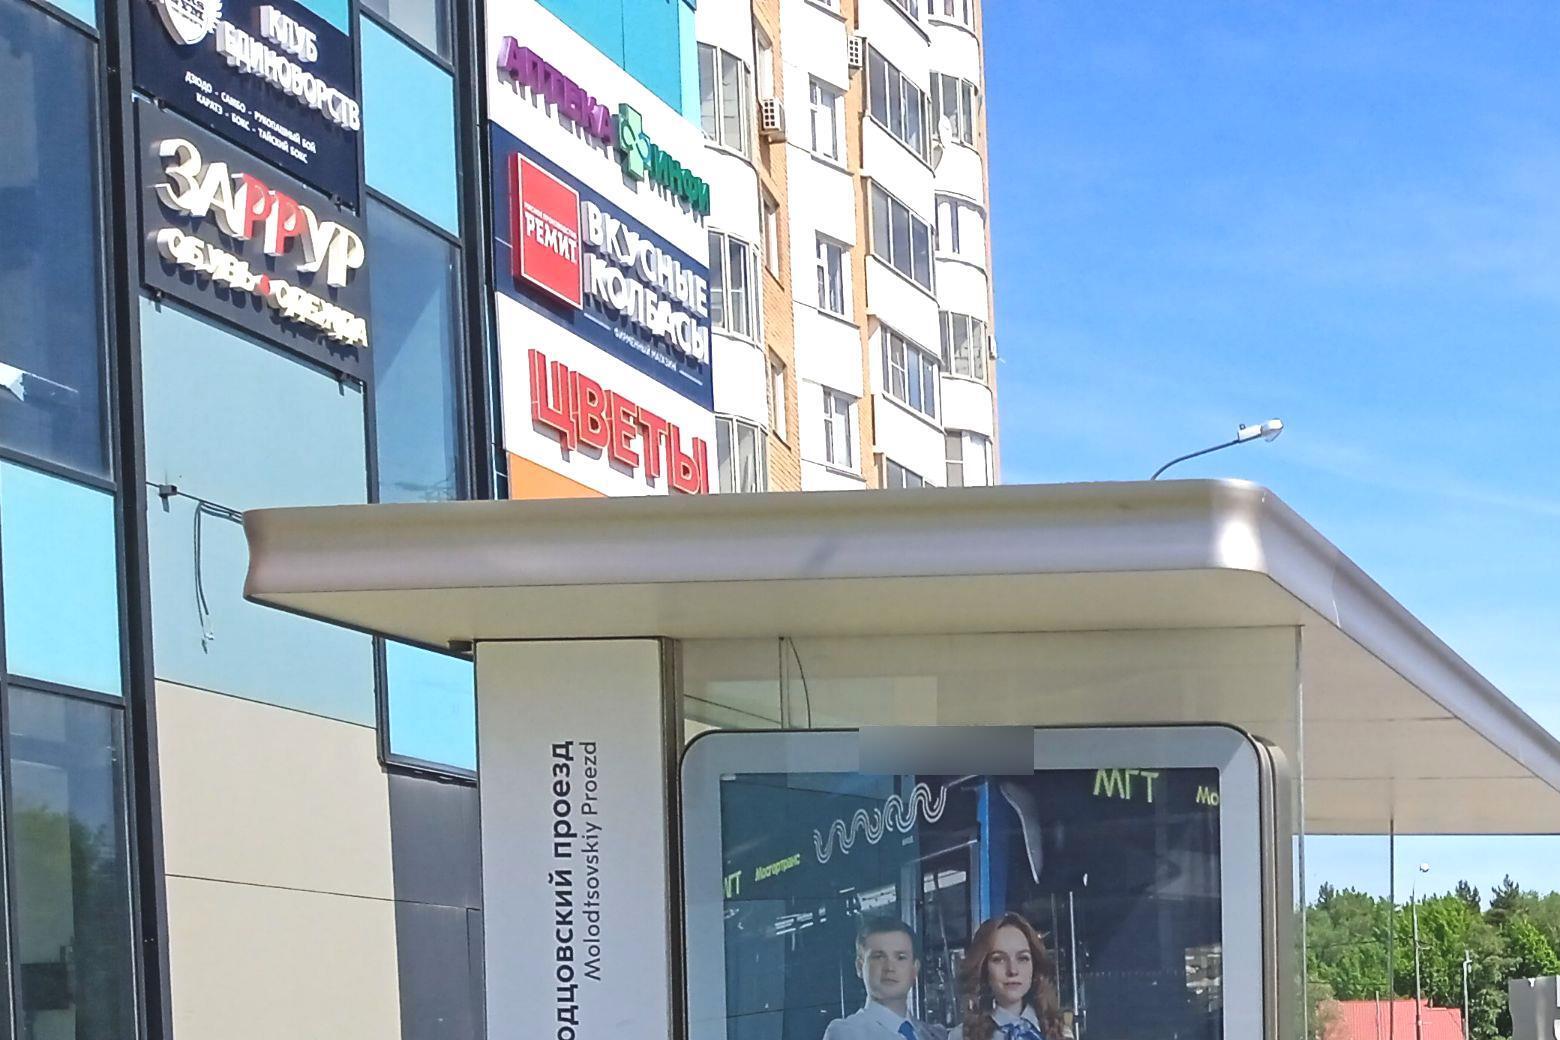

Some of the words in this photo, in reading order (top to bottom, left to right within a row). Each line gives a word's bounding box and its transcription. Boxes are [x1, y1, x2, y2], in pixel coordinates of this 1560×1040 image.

[216, 20, 361, 131] ЕДИНОБОРСТВ
[260, 5, 318, 63] КЛУБ
[497, 35, 612, 147] АПТЕКА
[154, 138, 365, 288] ЗАРРУР
[524, 211, 578, 265] РЕМИТ
[581, 200, 708, 319] ВКУСНЫЕ
[156, 227, 254, 293] ОБУВЬ
[267, 279, 369, 348] ОДЕЖДА
[584, 252, 709, 366] КОЛБАСЫ
[528, 348, 709, 495] ЦВЕТЫ
[551, 740, 578, 859] проезд
[579, 741, 599, 816] Proezd
[1093, 768, 1159, 803] МГТ
[579, 822, 602, 981] Molodtsovskiy
